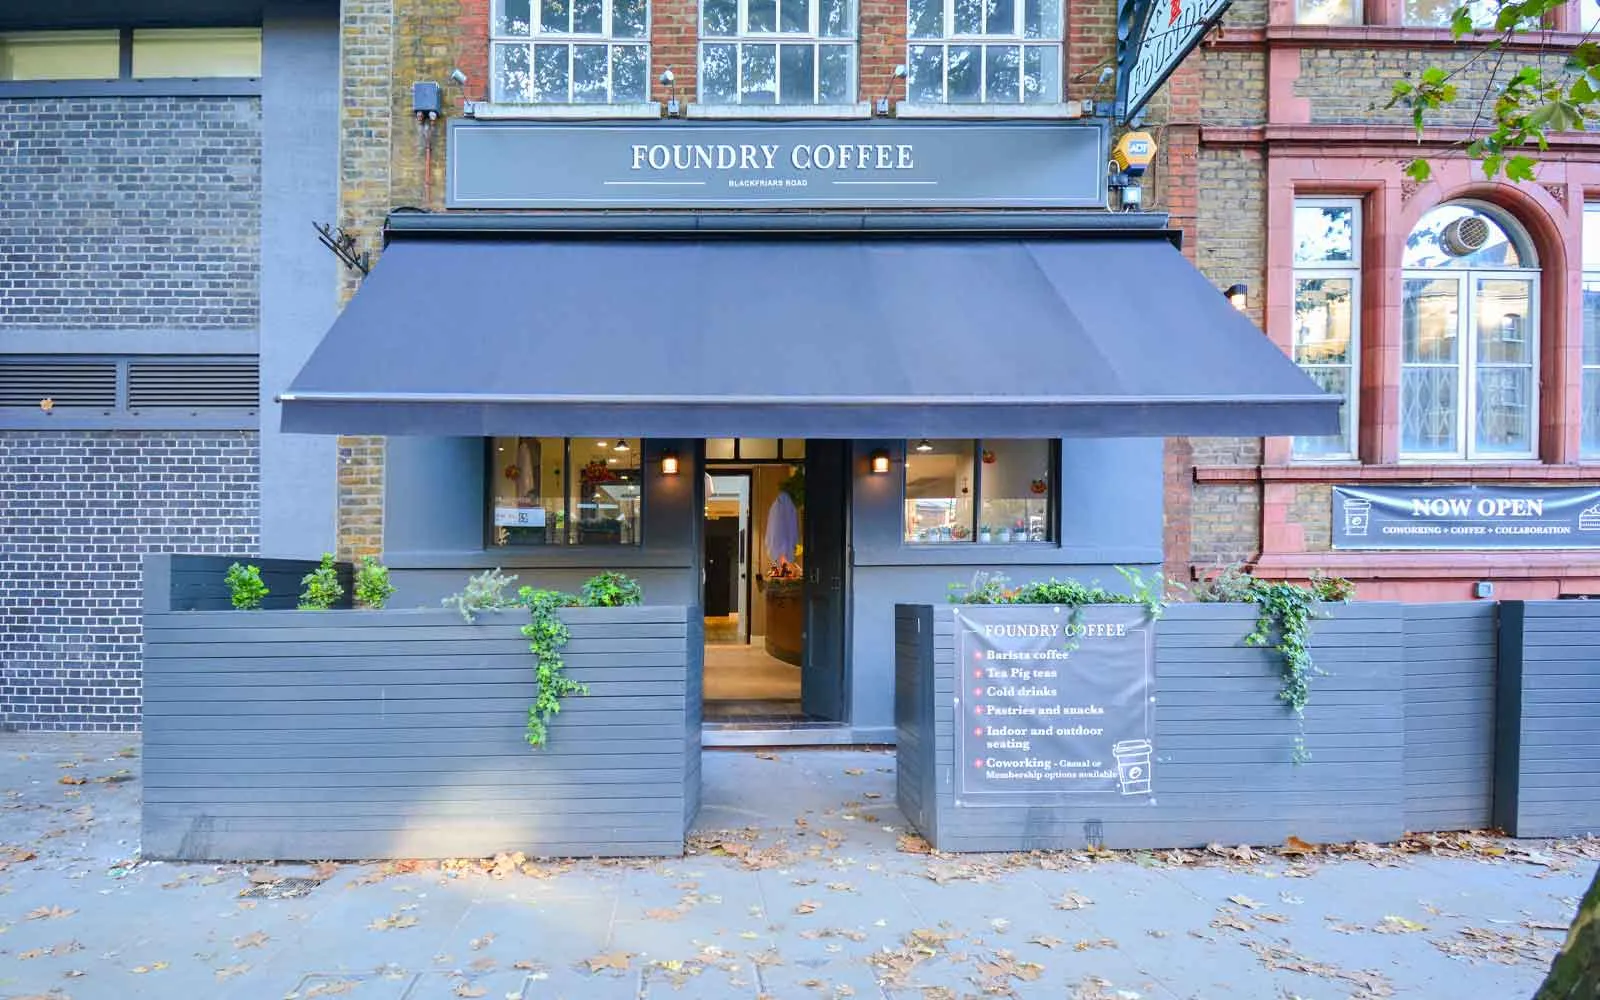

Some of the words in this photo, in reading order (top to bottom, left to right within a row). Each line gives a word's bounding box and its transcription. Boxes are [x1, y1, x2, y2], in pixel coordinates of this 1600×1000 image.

[631, 144, 779, 169] FOUNDRY
[791, 144, 914, 169] COFFEE
[728, 179, 783, 187] BLACKFRIARS
[785, 179, 808, 187] ROAD
[1413, 499, 1471, 516] NOW
[1478, 499, 1543, 516] OPEN
[1382, 526, 1442, 534] COWORKING
[1450, 526, 1487, 534] COFFEE
[1495, 526, 1571, 534] COLLABORATION
[985, 624, 1059, 637] FOUNDRY
[986, 650, 1030, 660] Barista
[1033, 649, 1069, 660] coffee
[986, 668, 1008, 678] Tea
[1011, 668, 1031, 680] Pig
[1033, 669, 1057, 678] teas
[986, 686, 1015, 697] Cold
[1017, 686, 1057, 697] drinks
[986, 705, 1036, 715] Pastries
[1038, 705, 1060, 715] and
[1063, 705, 1104, 714] snacks
[986, 726, 1027, 736] Indoor
[1030, 726, 1053, 736] and
[1056, 725, 1103, 736] outdoor
[986, 739, 1030, 751] seating
[986, 758, 1051, 770] Coworking
